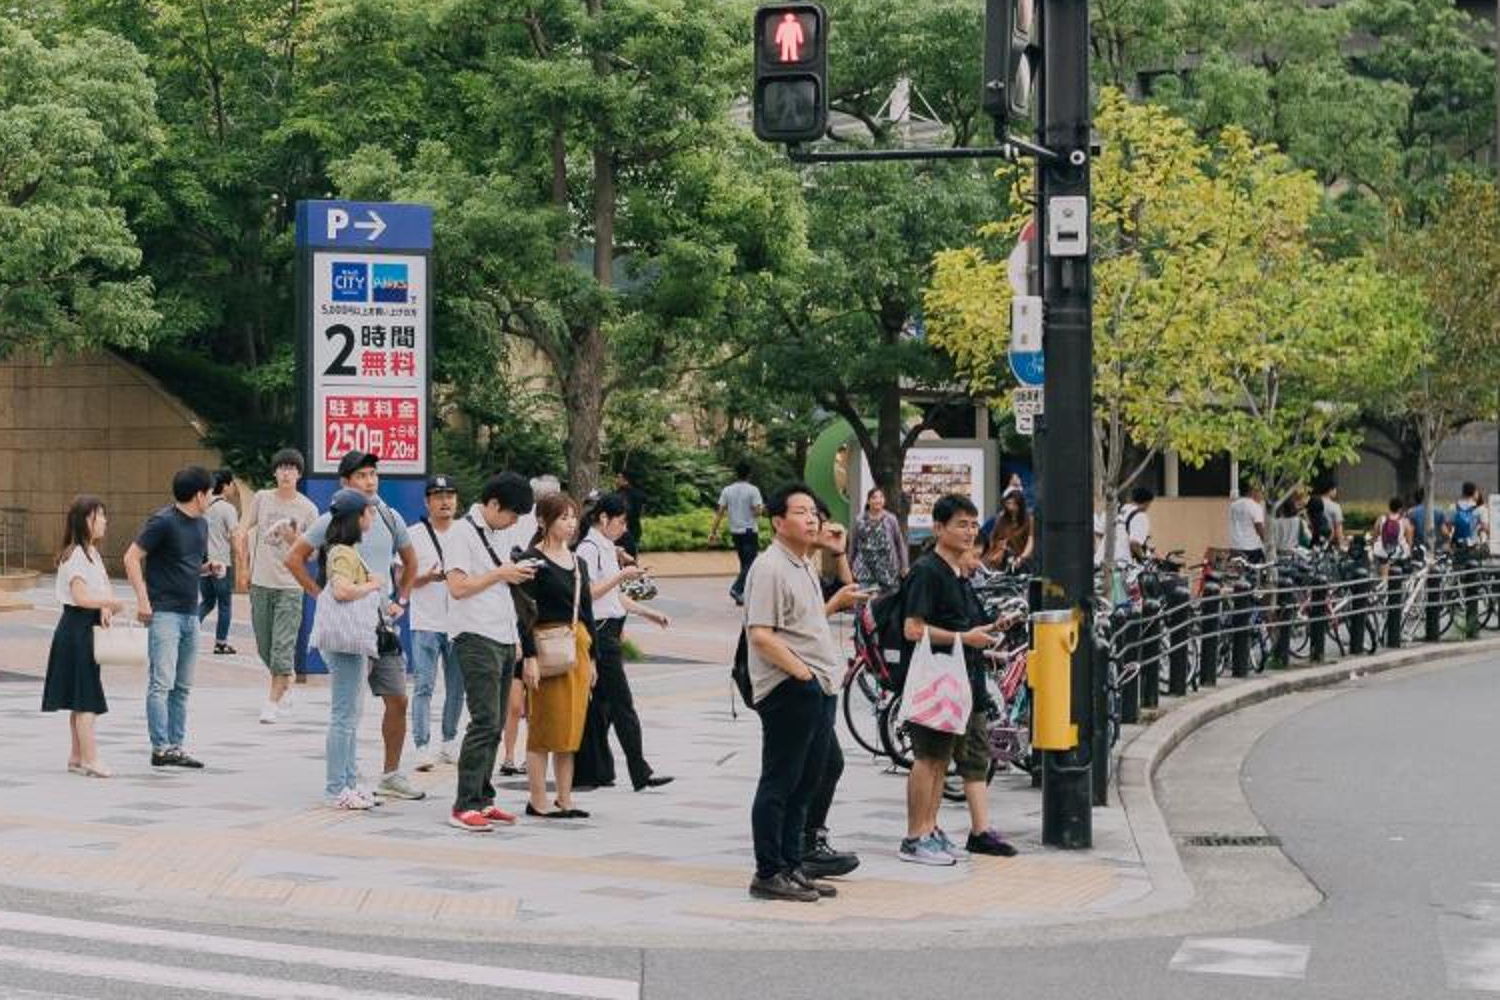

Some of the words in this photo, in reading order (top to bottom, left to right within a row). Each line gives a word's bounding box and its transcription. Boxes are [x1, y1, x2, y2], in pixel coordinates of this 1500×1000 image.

[326, 208, 349, 239] P
[334, 275, 365, 289] CITY
[360, 350, 416, 377] 無料
[328, 399, 416, 419] 駐車料金
